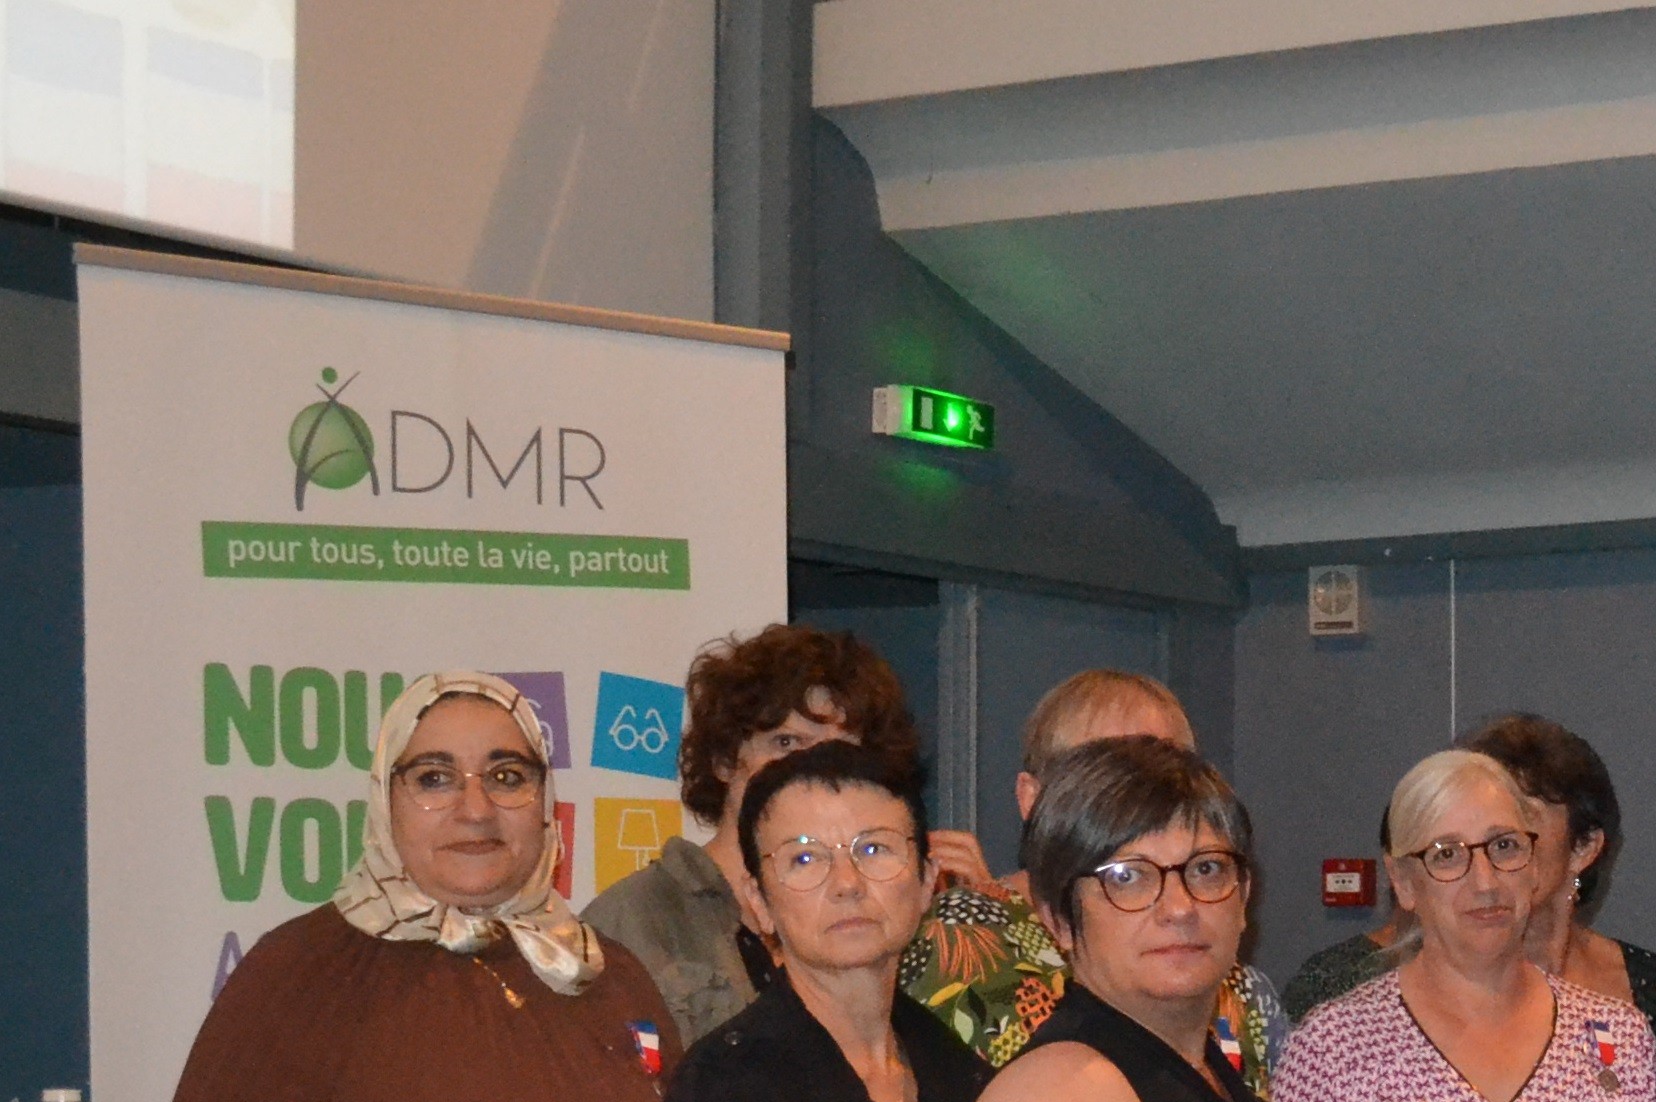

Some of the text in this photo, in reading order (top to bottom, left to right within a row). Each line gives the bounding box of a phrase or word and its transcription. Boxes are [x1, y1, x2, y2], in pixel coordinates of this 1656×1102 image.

[289, 367, 605, 512] ADMR
[228, 537, 670, 577] pour tous, toute la vie, partout
[203, 663, 404, 769] NOU
